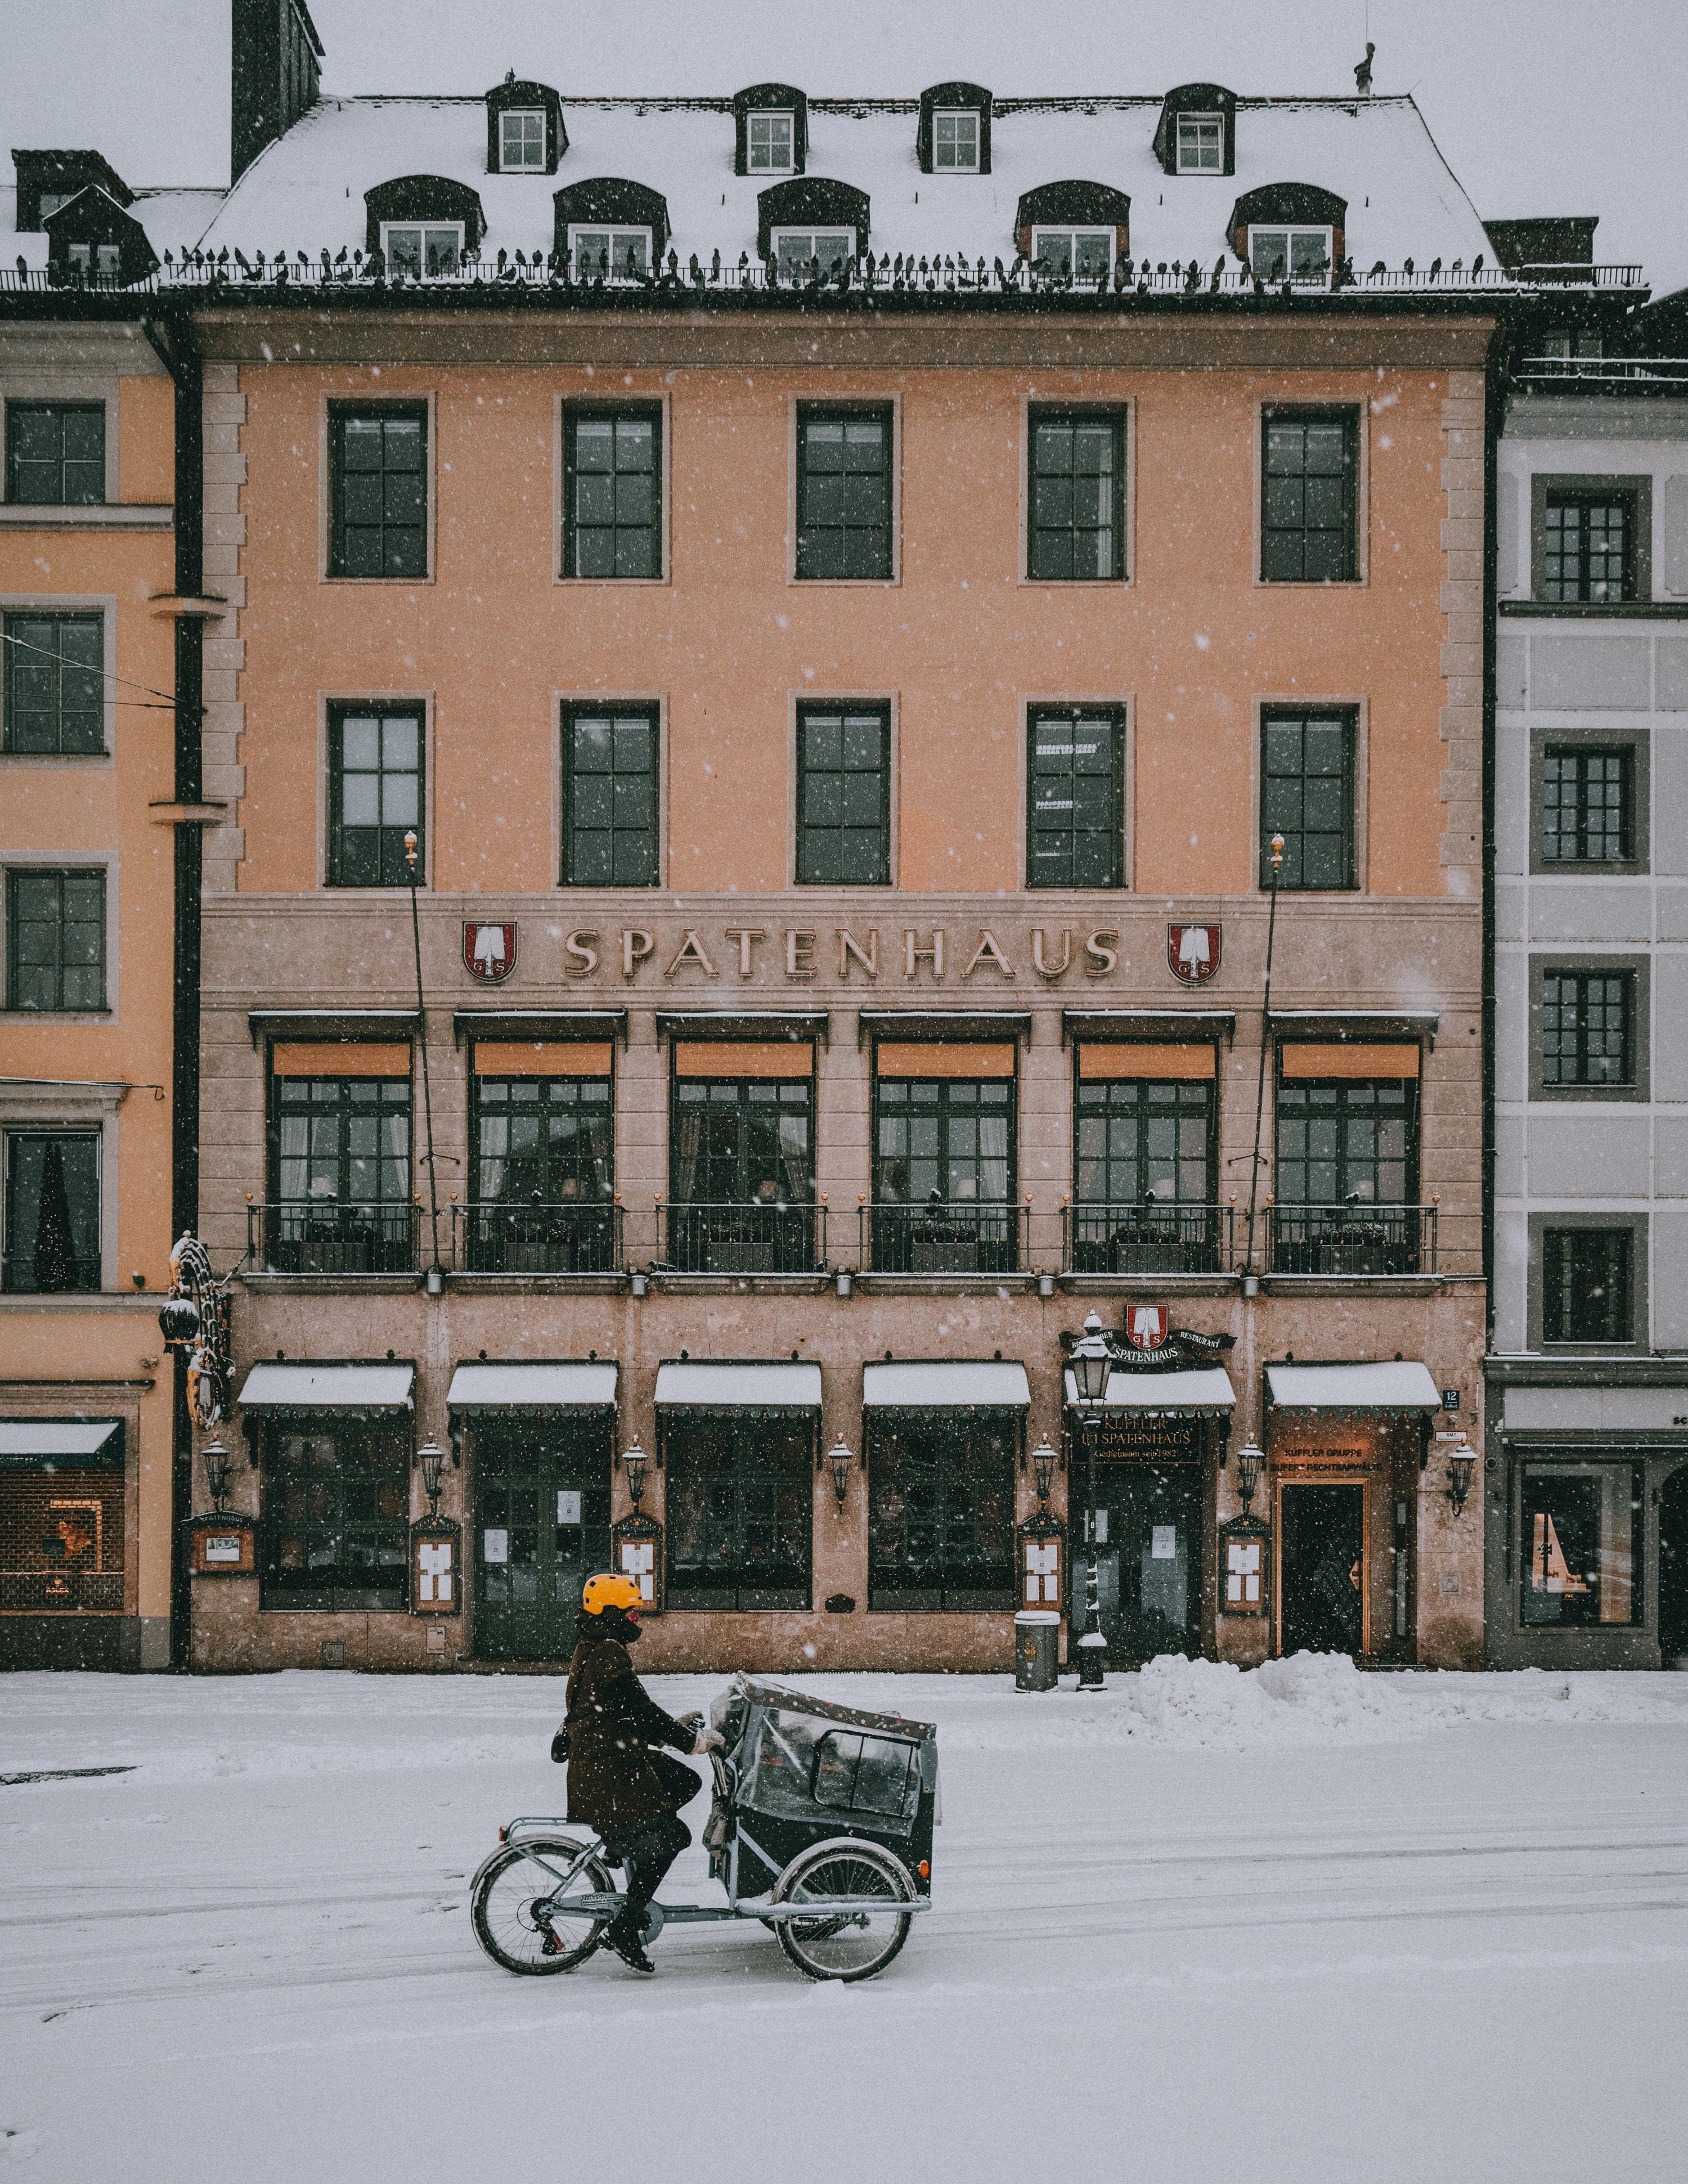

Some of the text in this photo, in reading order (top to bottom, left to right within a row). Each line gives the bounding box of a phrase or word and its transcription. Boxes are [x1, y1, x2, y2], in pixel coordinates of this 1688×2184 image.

[564, 928, 1119, 977] SPATENHAUS
[473, 962, 505, 971] G S
[1178, 964, 1210, 973] G S
[1180, 1331, 1219, 1348] RESTAURANT
[1115, 1347, 1178, 1362] SPATENHAUS
[1447, 1391, 1457, 1400] 12
[1101, 1433, 1191, 1444] SPATENHAUS
